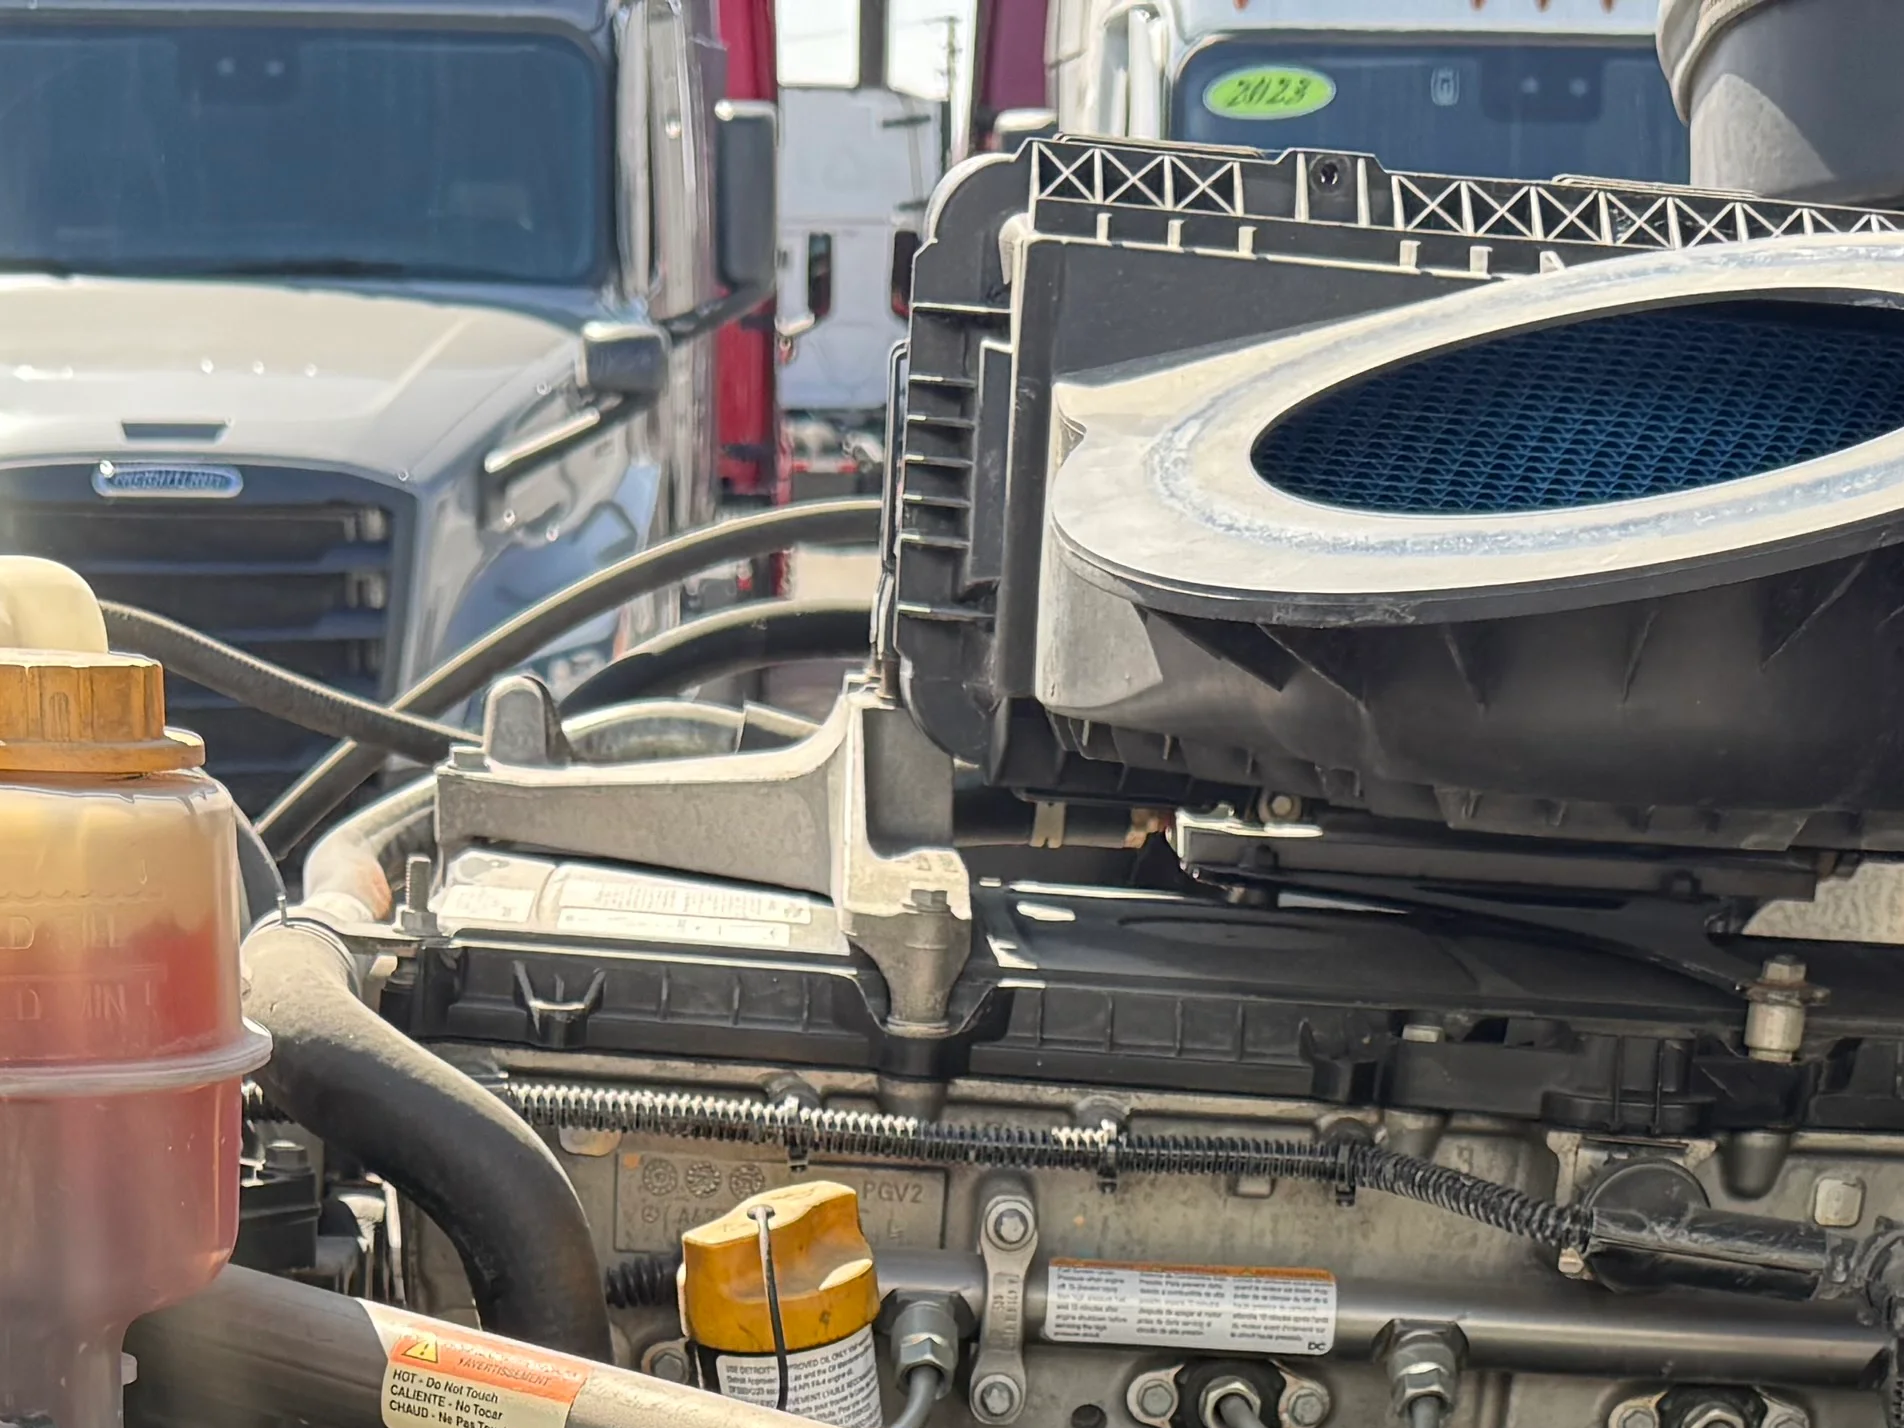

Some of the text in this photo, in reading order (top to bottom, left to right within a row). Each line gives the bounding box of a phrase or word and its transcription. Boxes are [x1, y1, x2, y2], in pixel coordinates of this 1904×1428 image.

[1226, 76, 1312, 108] 2023
[862, 1181, 923, 1203] PGV2
[390, 1384, 503, 1421] CALIENTE No Tocar
[393, 1369, 498, 1404] HOT Do Not Touch
[389, 1400, 429, 1419] CHAUD
[439, 1412, 452, 1424] Ne
